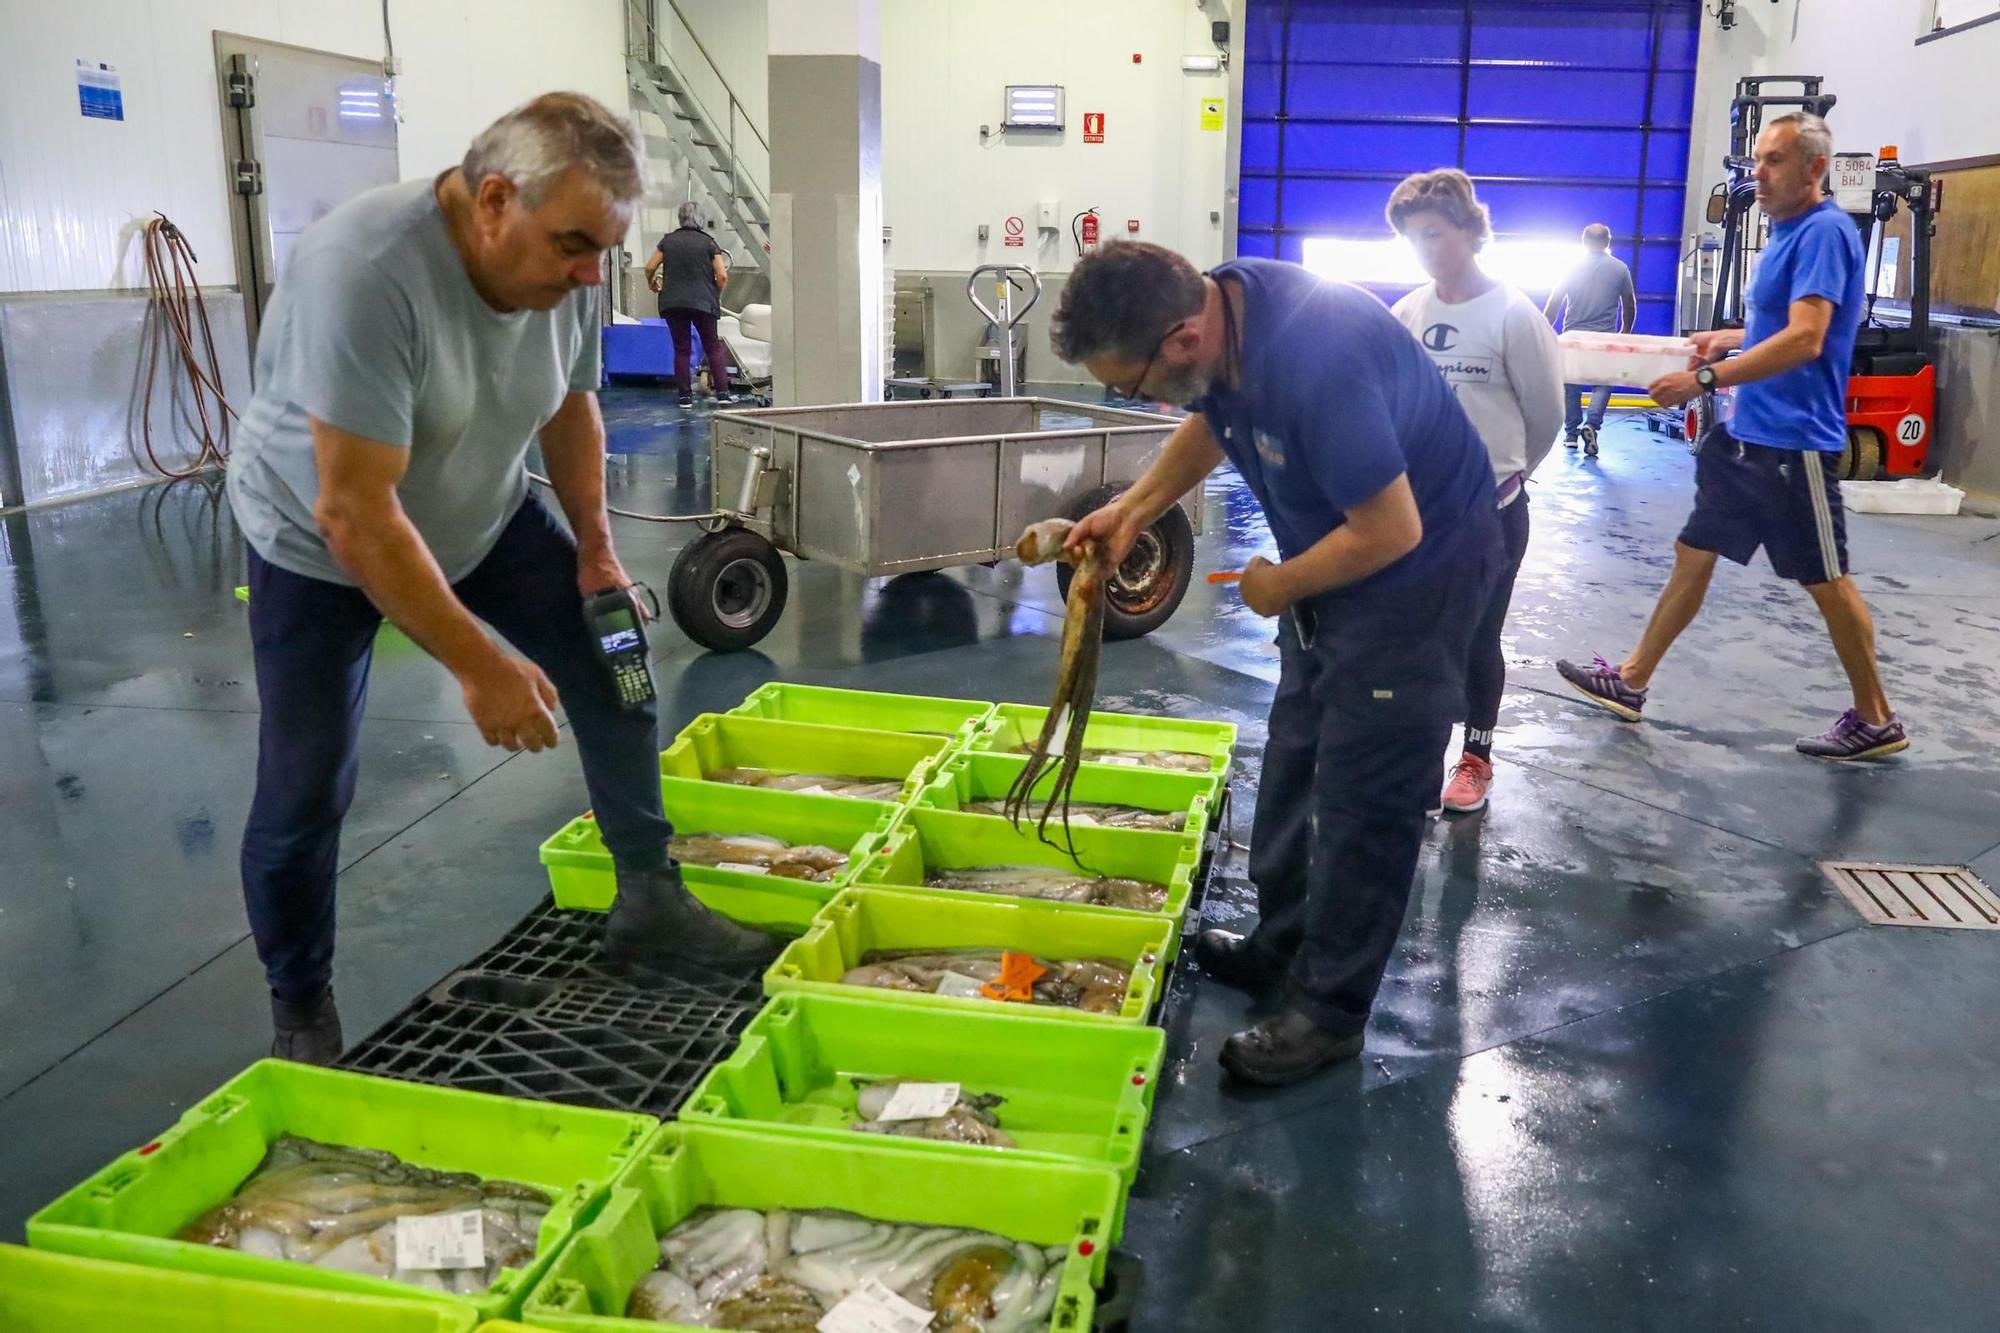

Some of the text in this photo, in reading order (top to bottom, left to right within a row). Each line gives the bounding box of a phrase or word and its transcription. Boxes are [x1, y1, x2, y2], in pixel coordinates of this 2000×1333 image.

[1835, 160, 1871, 171] E 5084
[1841, 175, 1864, 186] BHJ
[1902, 420, 1920, 440] 20
[1469, 727, 1492, 746] PU
